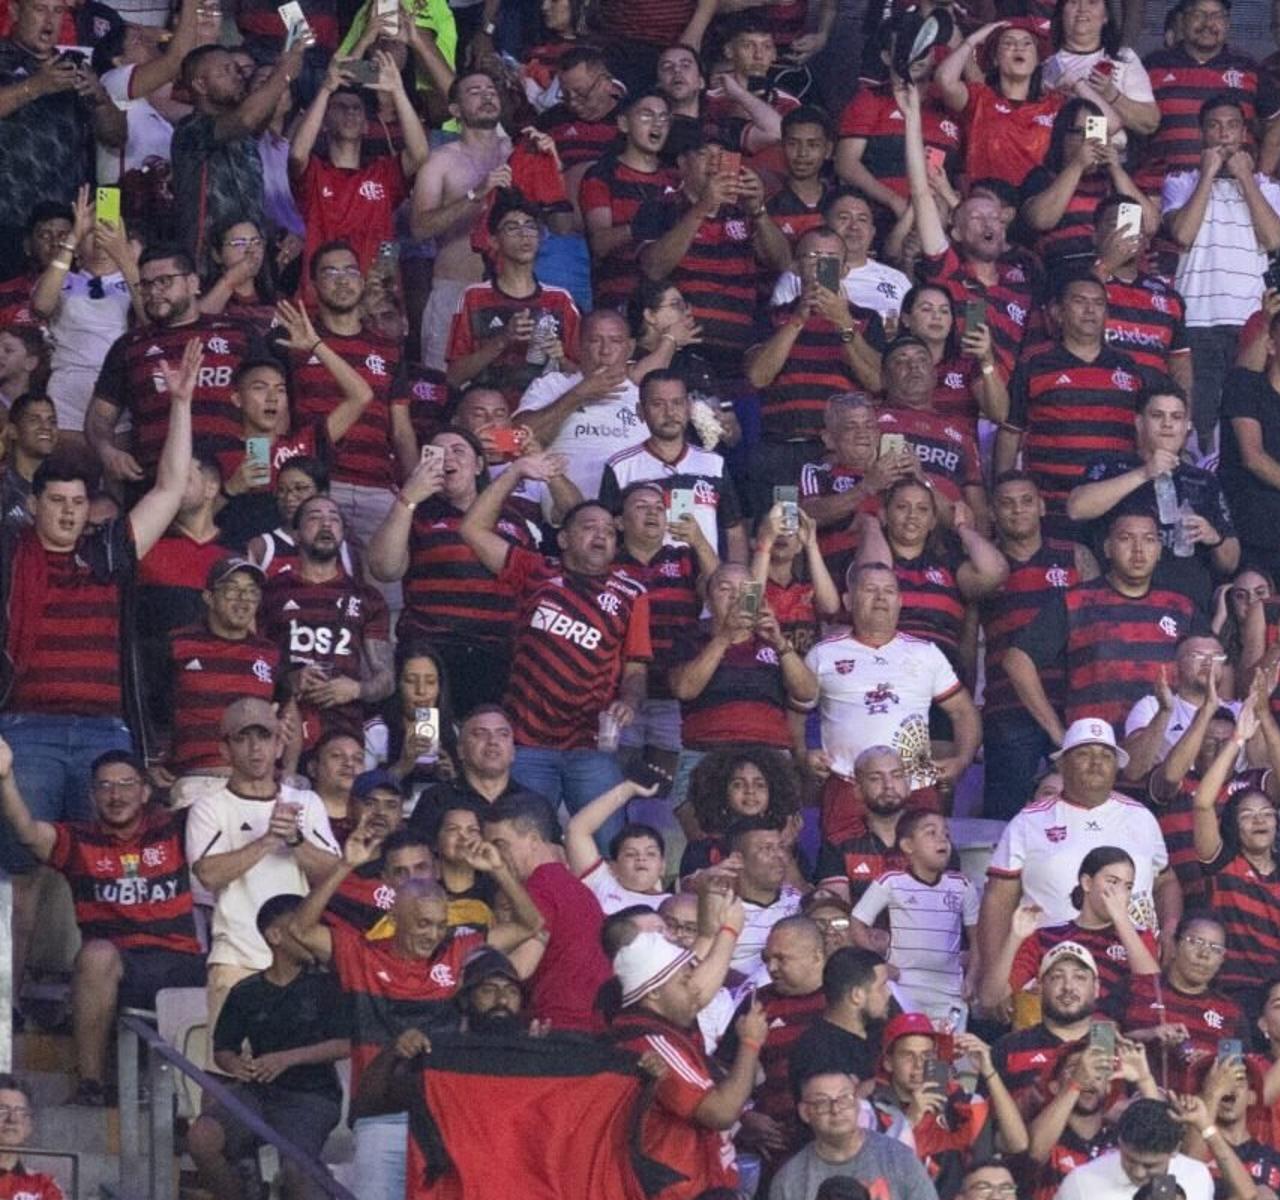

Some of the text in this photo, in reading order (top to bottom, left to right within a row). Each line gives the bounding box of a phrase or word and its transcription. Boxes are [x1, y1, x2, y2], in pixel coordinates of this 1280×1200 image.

[198, 365, 231, 388] RB
[914, 444, 958, 472] BRB
[290, 618, 351, 655] bs2
[550, 615, 602, 650] BRB
